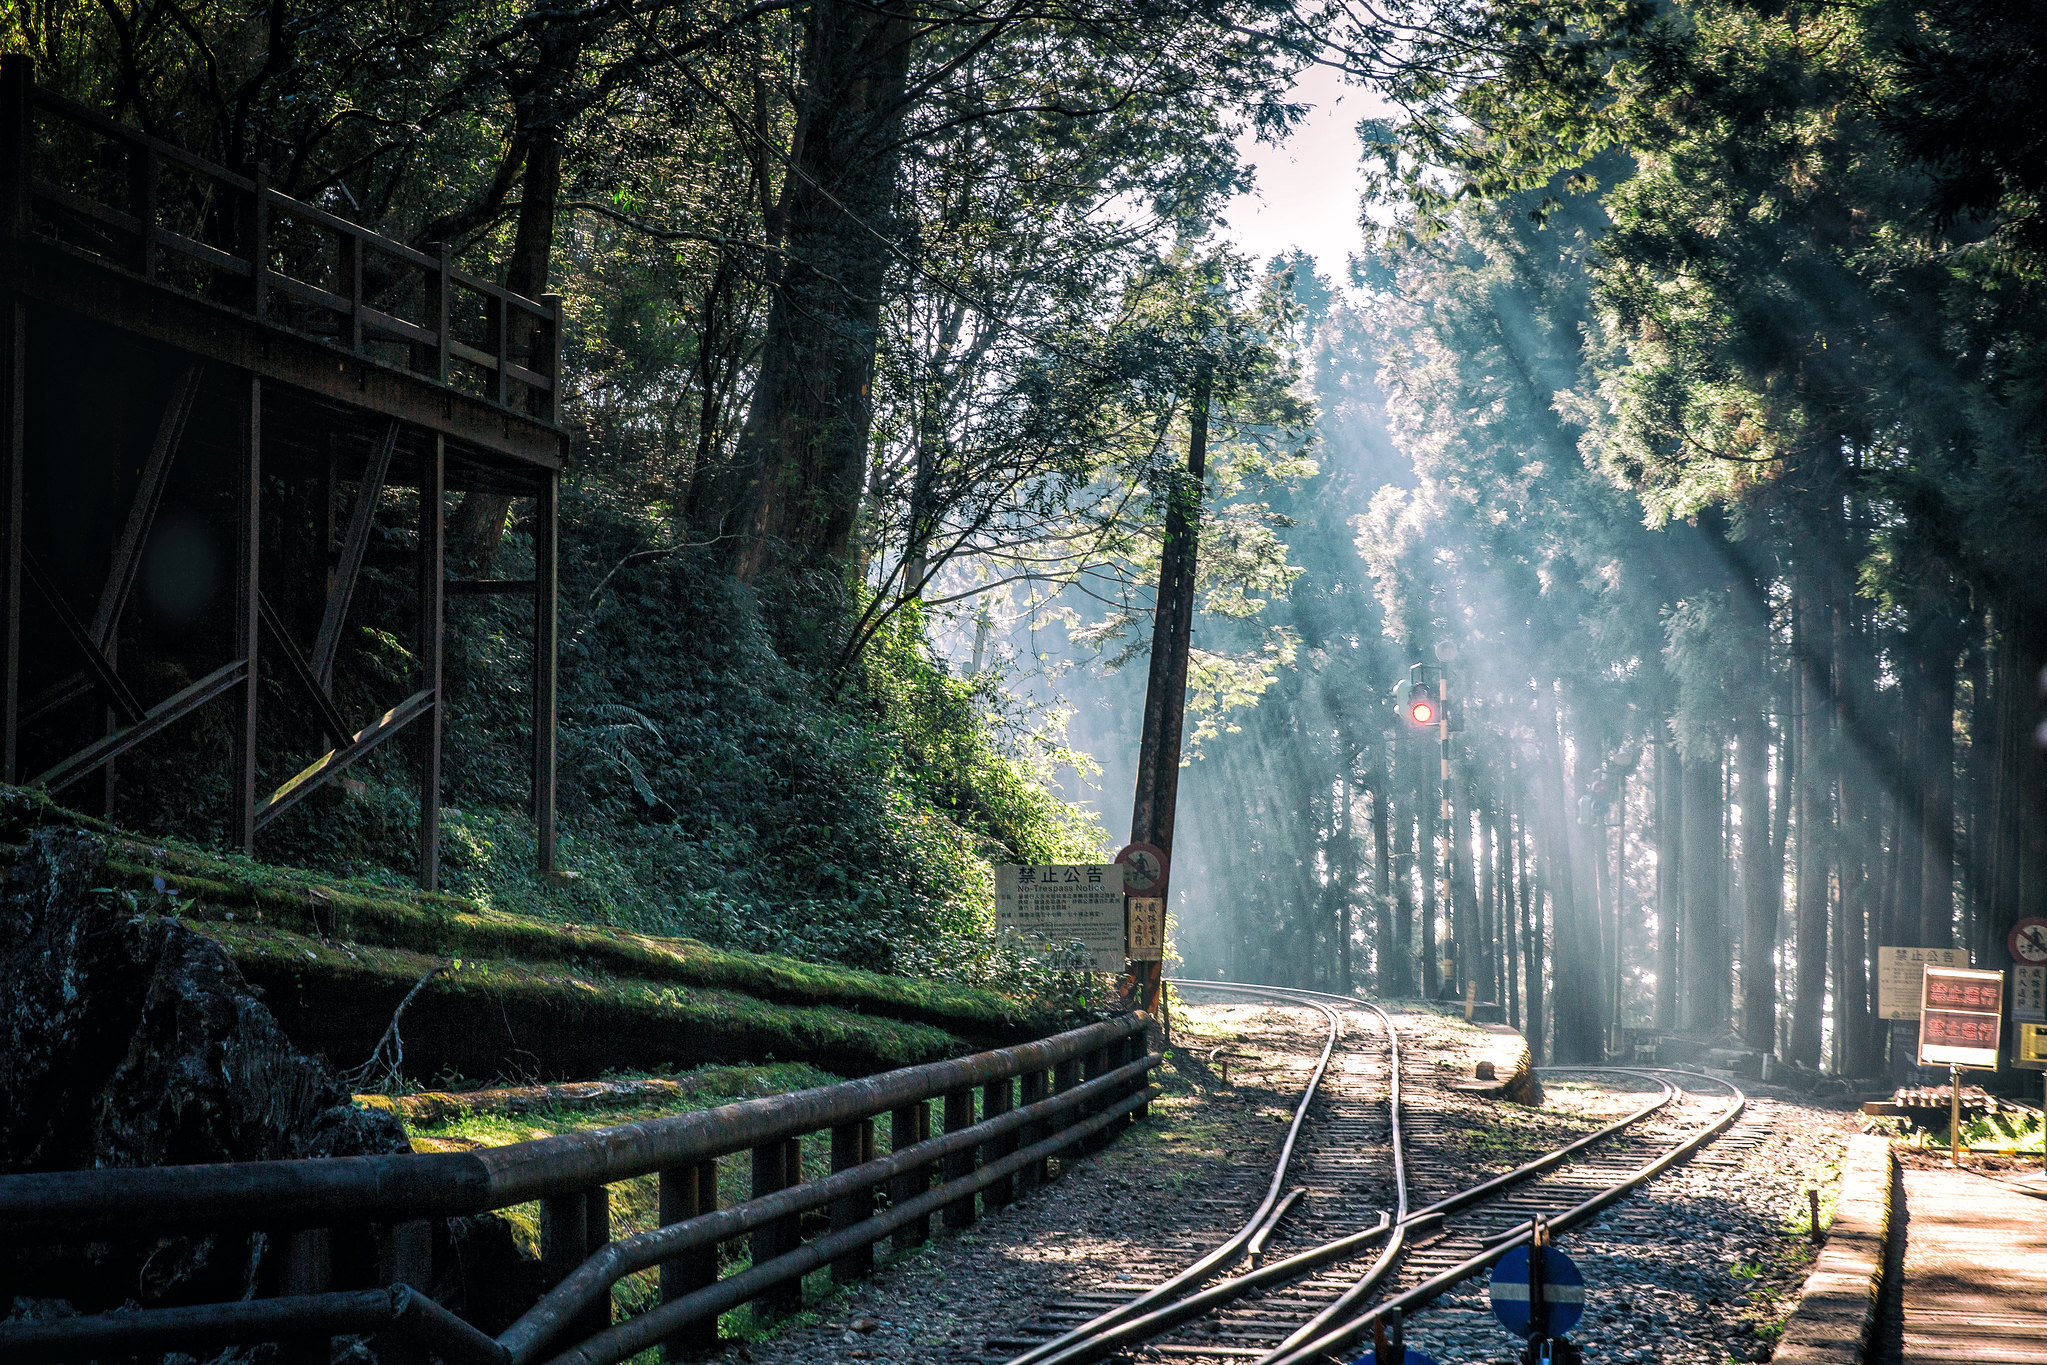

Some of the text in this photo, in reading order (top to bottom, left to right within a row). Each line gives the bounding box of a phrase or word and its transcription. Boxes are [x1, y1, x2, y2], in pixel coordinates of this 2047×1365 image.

[1018, 865, 1103, 884] 禁止公告
[1017, 884, 1106, 893] No-Trespass Notice
[1895, 948, 1955, 962] 禁止公告
[1930, 982, 1998, 1006] 禁止通行
[1927, 1018, 1995, 1041] 禁止通行
